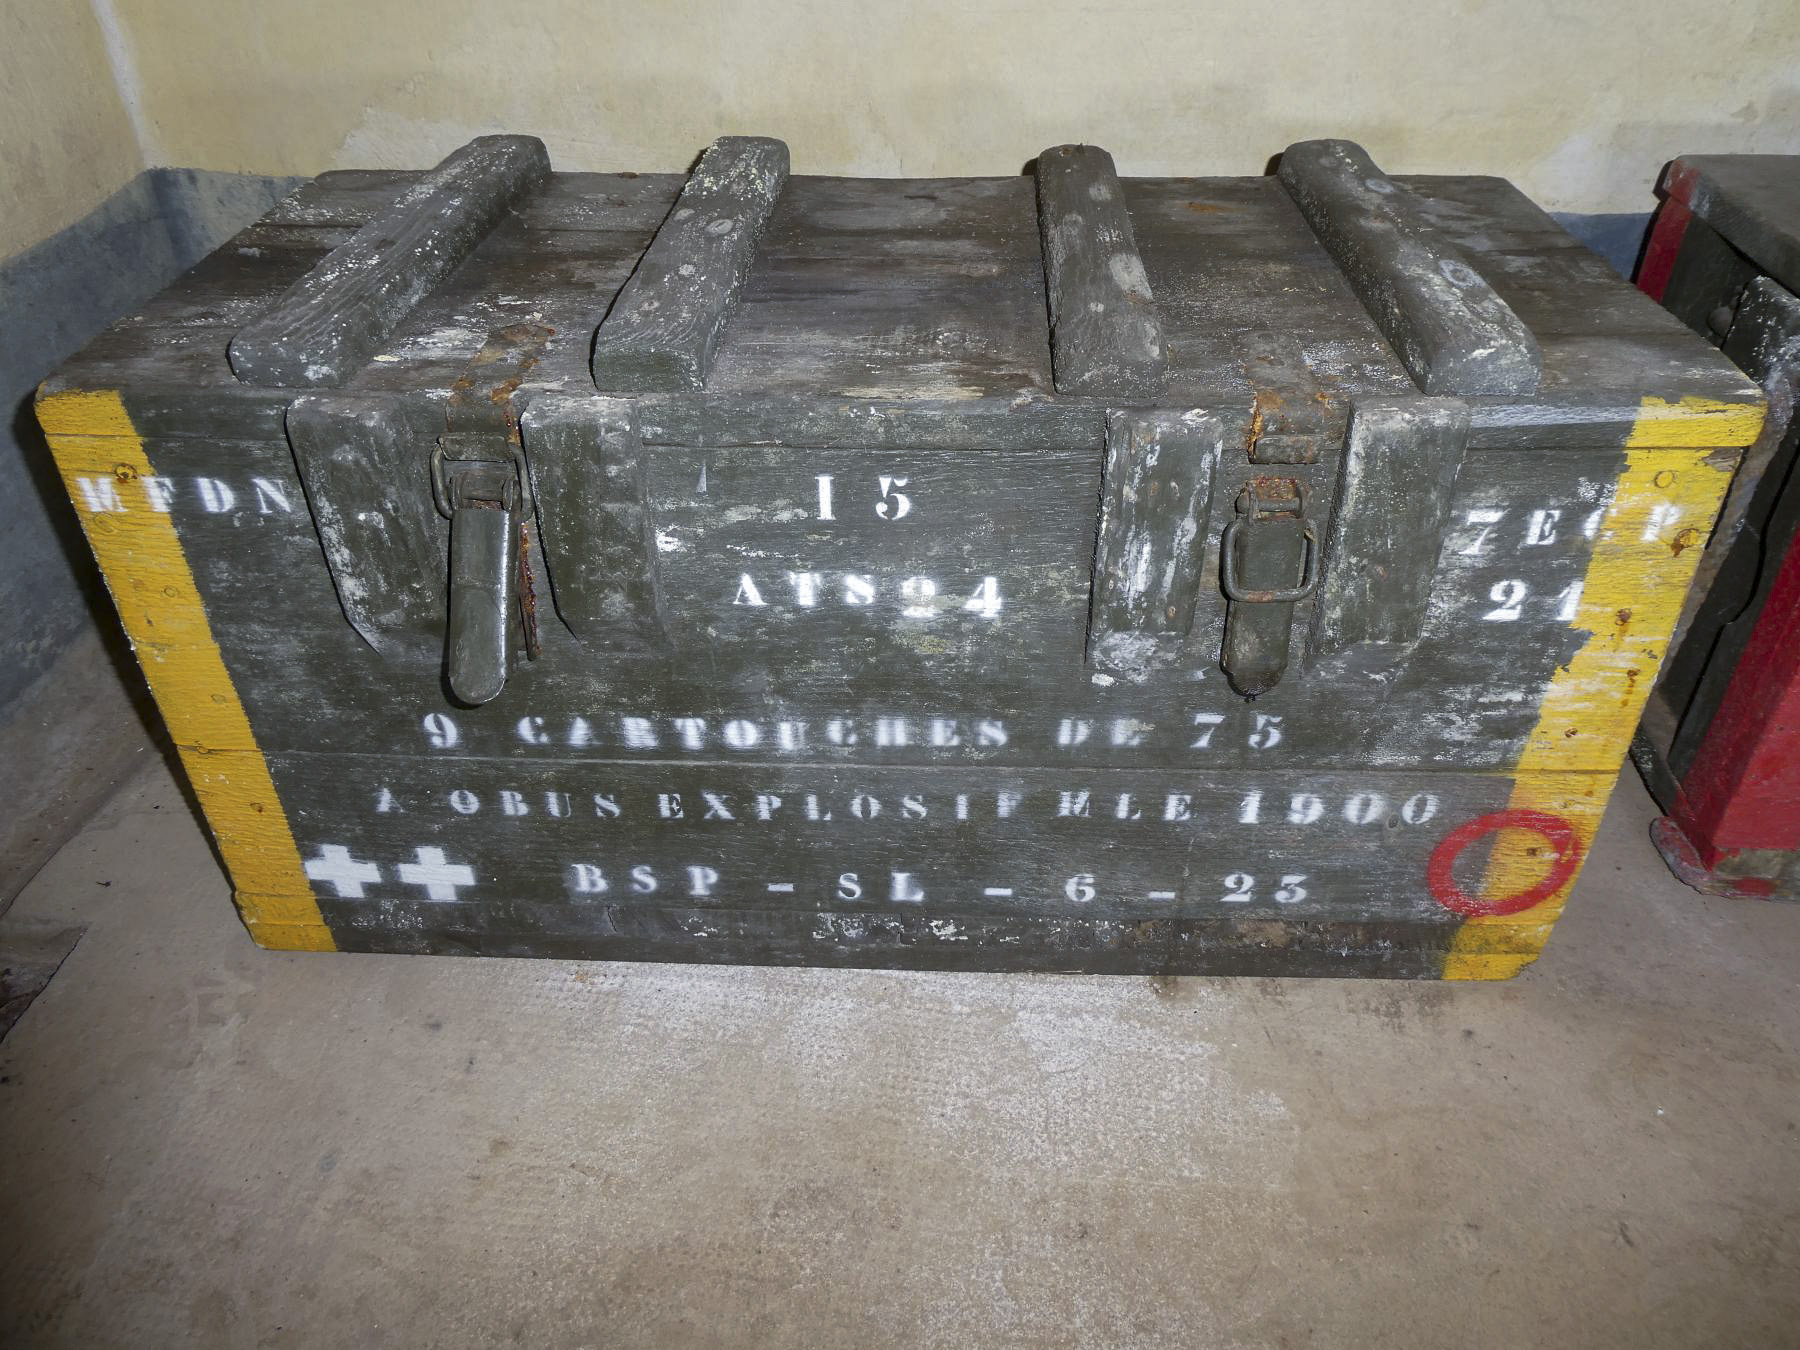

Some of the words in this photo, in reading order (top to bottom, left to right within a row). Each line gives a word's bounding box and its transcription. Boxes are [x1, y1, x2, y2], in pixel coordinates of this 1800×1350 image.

[815, 475, 912, 520] 15
[423, 712, 458, 749] 9
[517, 716, 1008, 752] CARTOUCHES
[1057, 717, 1147, 748] DE
[1190, 712, 1283, 748] 75
[449, 788, 622, 819] OBUS
[658, 791, 1023, 822] EXPLOSIF
[1238, 790, 1440, 826] 1900
[571, 863, 720, 896] BSP
[1065, 872, 1096, 903] 6
[1219, 872, 1308, 903] 23
